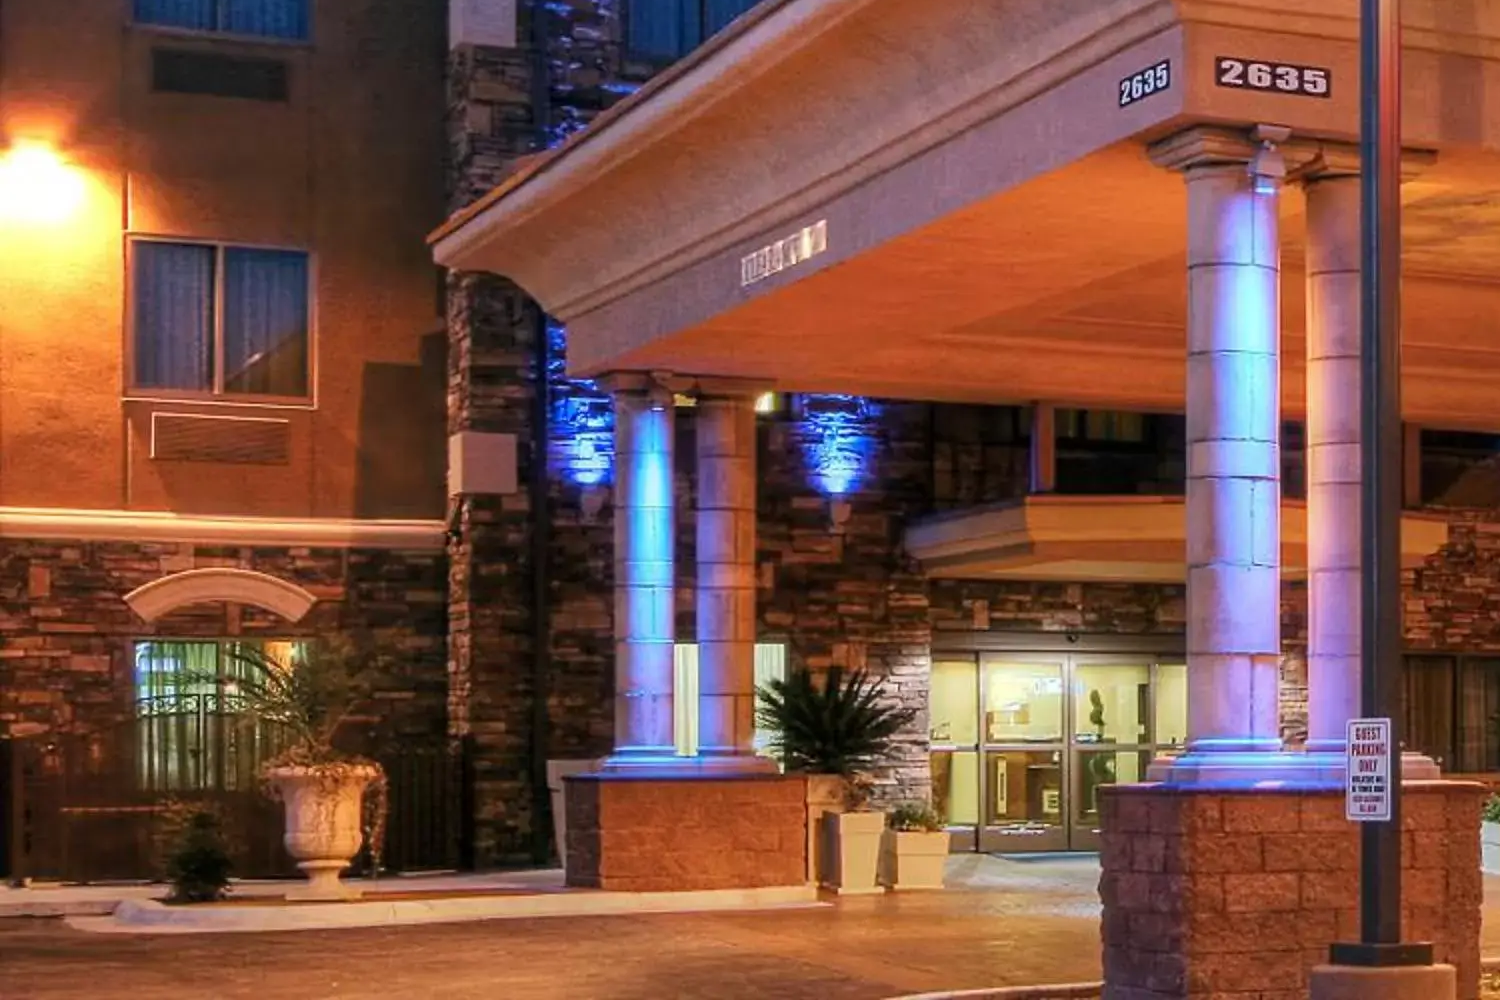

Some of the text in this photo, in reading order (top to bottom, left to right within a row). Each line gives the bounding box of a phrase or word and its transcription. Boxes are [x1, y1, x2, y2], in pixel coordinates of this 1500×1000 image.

[1220, 60, 1328, 94] 2635
[1120, 63, 1168, 105] 2635
[1355, 727, 1381, 740] GUEST
[1351, 743, 1386, 756] PARKING
[1359, 759, 1378, 772] ONLY
